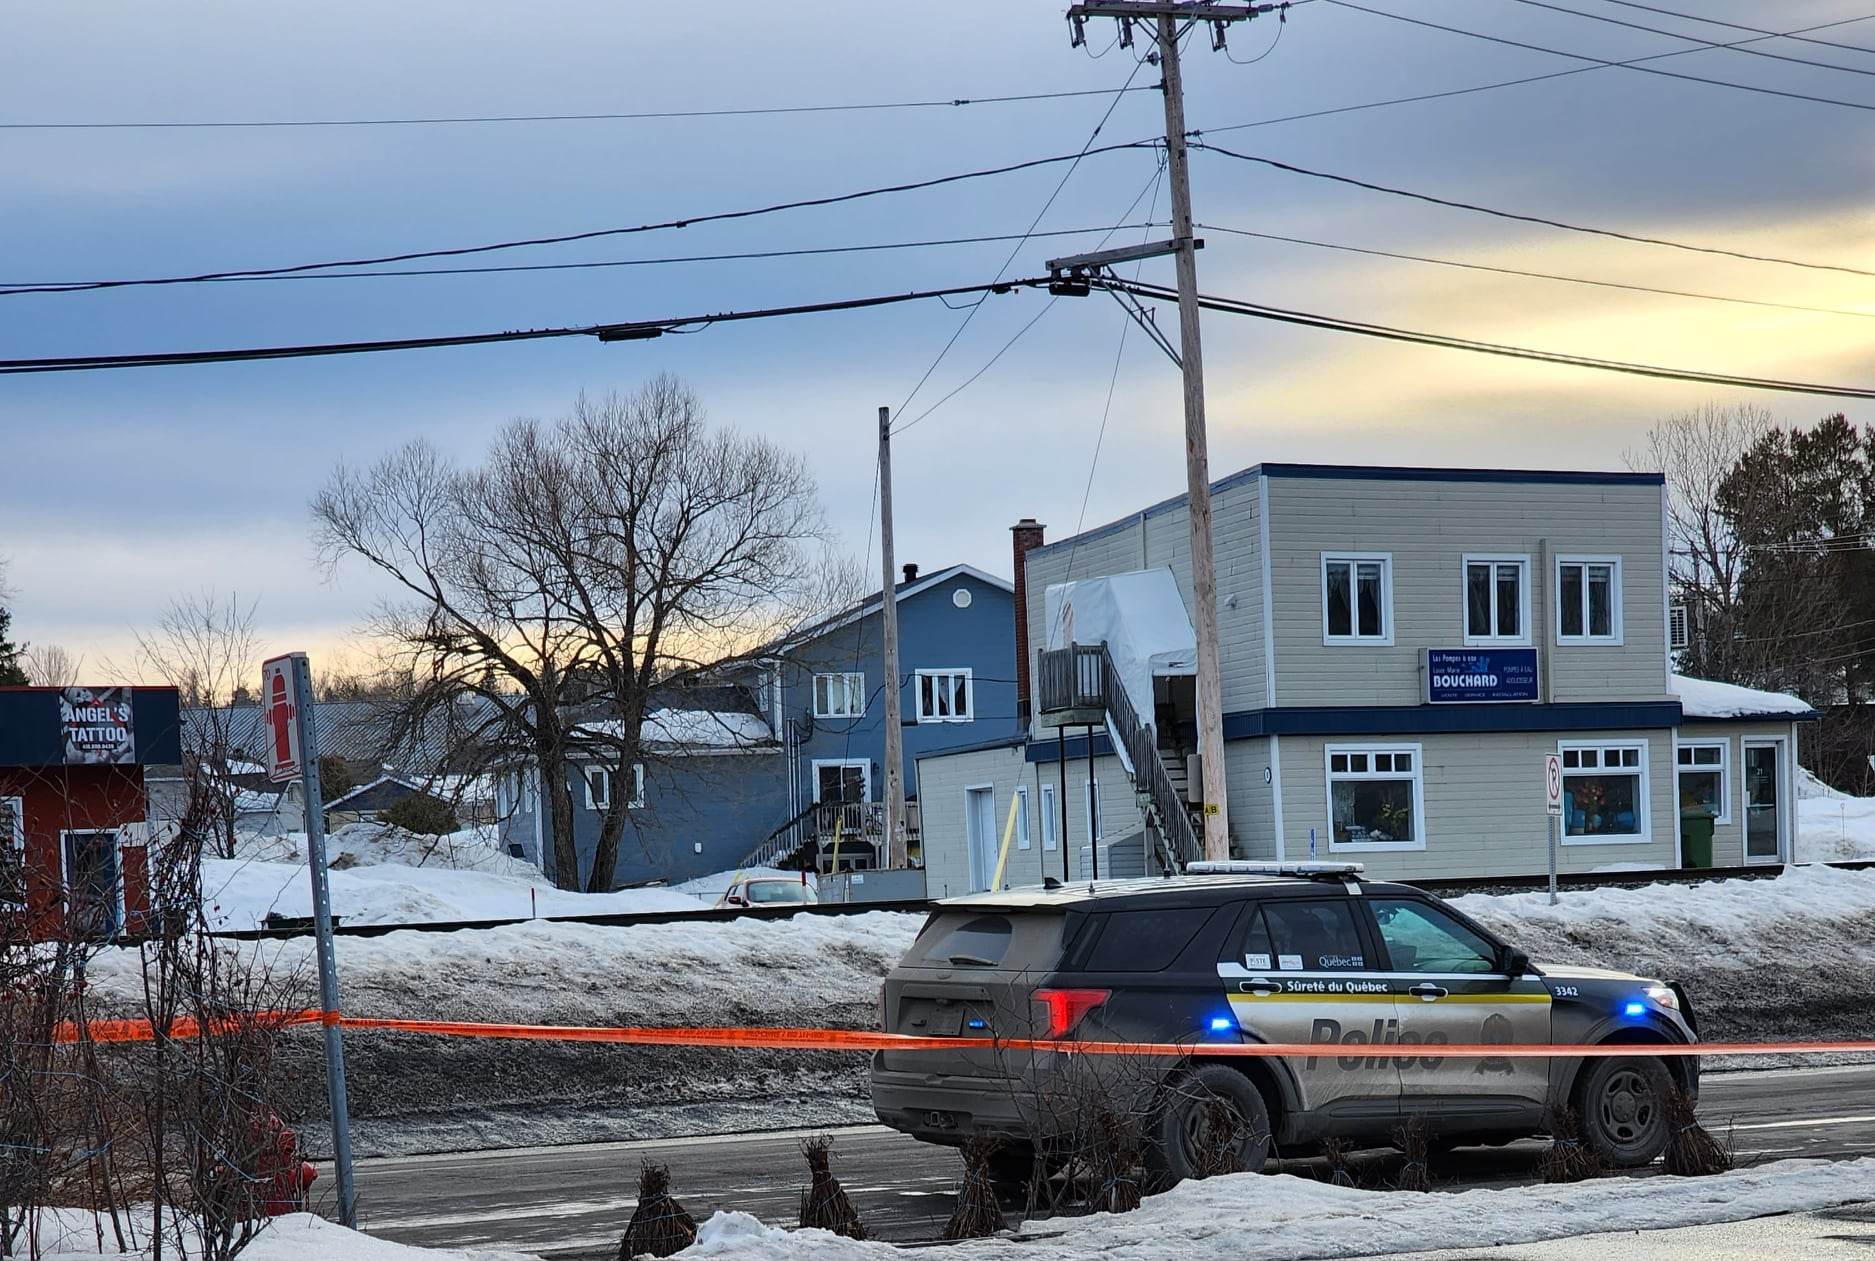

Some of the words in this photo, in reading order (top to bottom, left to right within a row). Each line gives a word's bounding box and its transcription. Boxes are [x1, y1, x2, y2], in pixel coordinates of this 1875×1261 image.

[1442, 653, 1461, 663] Pompes
[1433, 674, 1498, 688] BOUCHARD
[65, 706, 129, 723] ANGEL'S
[69, 727, 127, 742] TATTOO
[1319, 955, 1352, 968] Québec
[1287, 980, 1325, 992] Sûreté
[1328, 981, 1343, 992] du
[1346, 981, 1388, 994] Québec
[1554, 986, 1579, 996] 3342
[1305, 1018, 1449, 1071] Police
